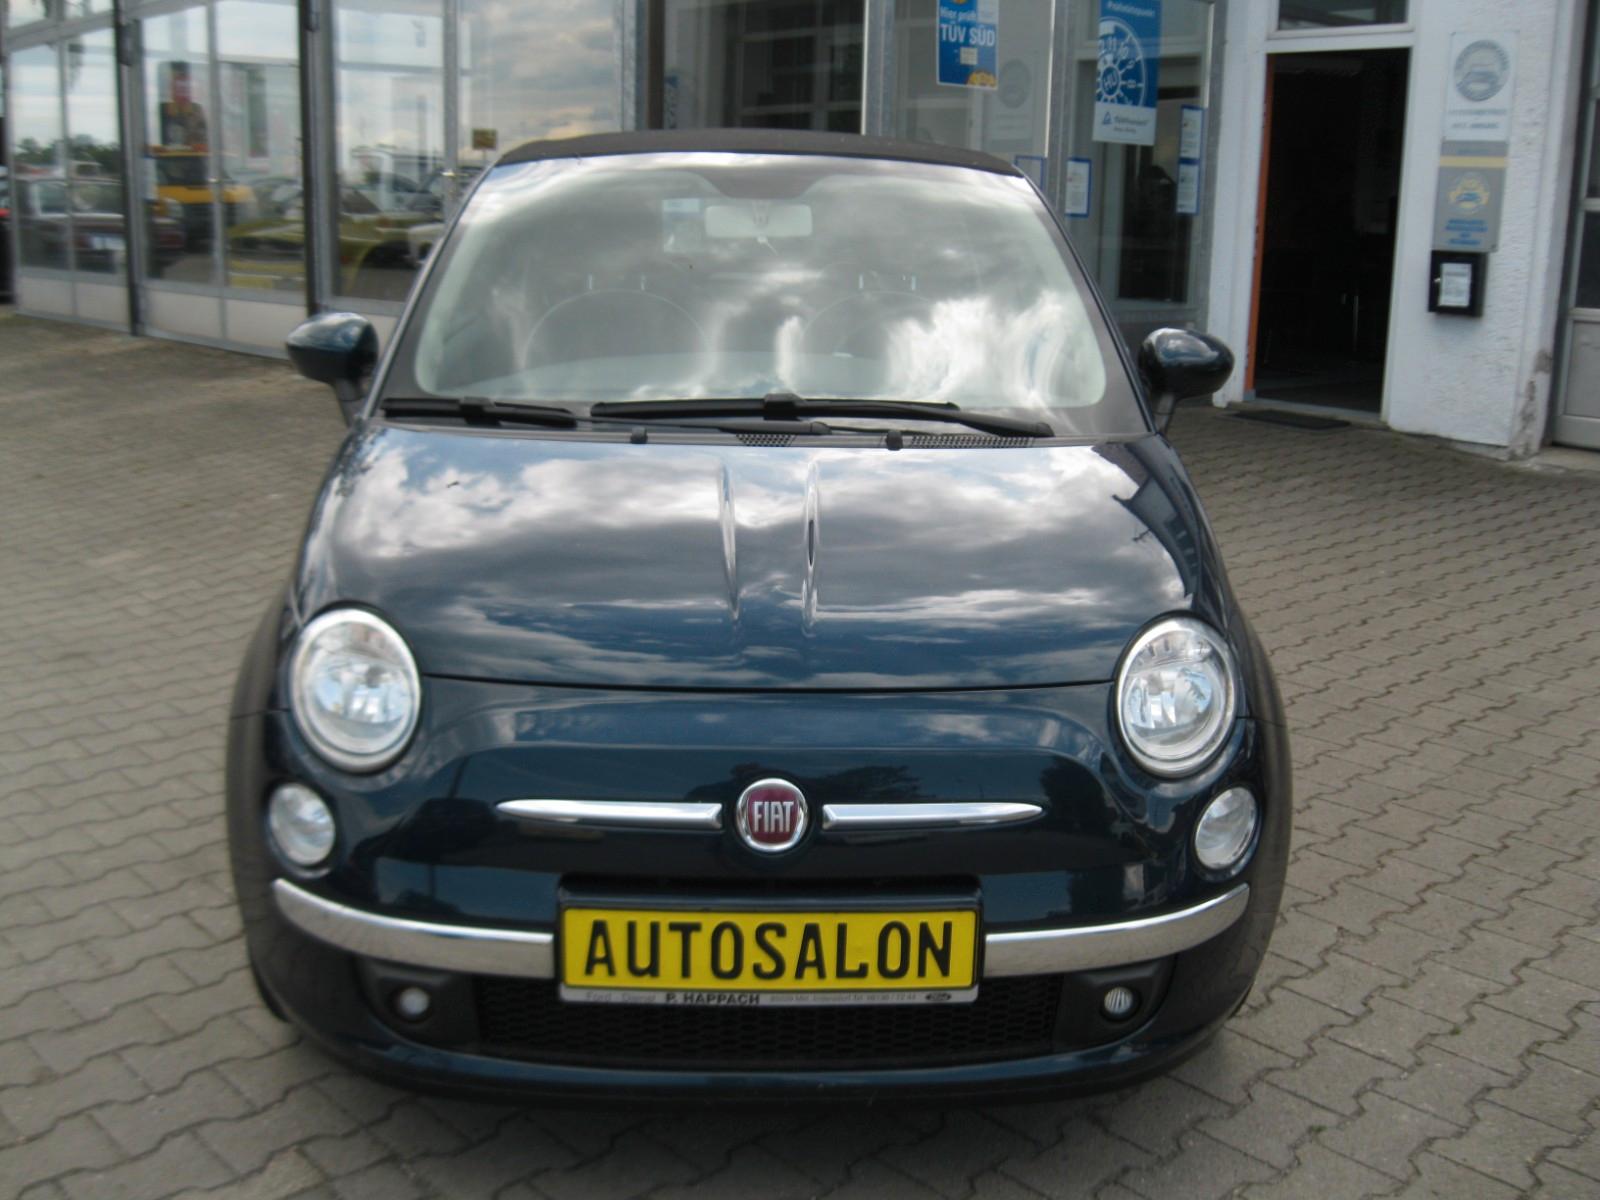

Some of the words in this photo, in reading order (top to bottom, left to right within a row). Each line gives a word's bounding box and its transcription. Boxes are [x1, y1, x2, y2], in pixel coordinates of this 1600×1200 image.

[940, 21, 966, 43] TÜV
[969, 24, 995, 46] SÜD
[752, 800, 794, 833] FIAT
[584, 918, 953, 981] AUTOSALON
[666, 992, 678, 1004] P.
[683, 992, 760, 1005] HAPPACH
